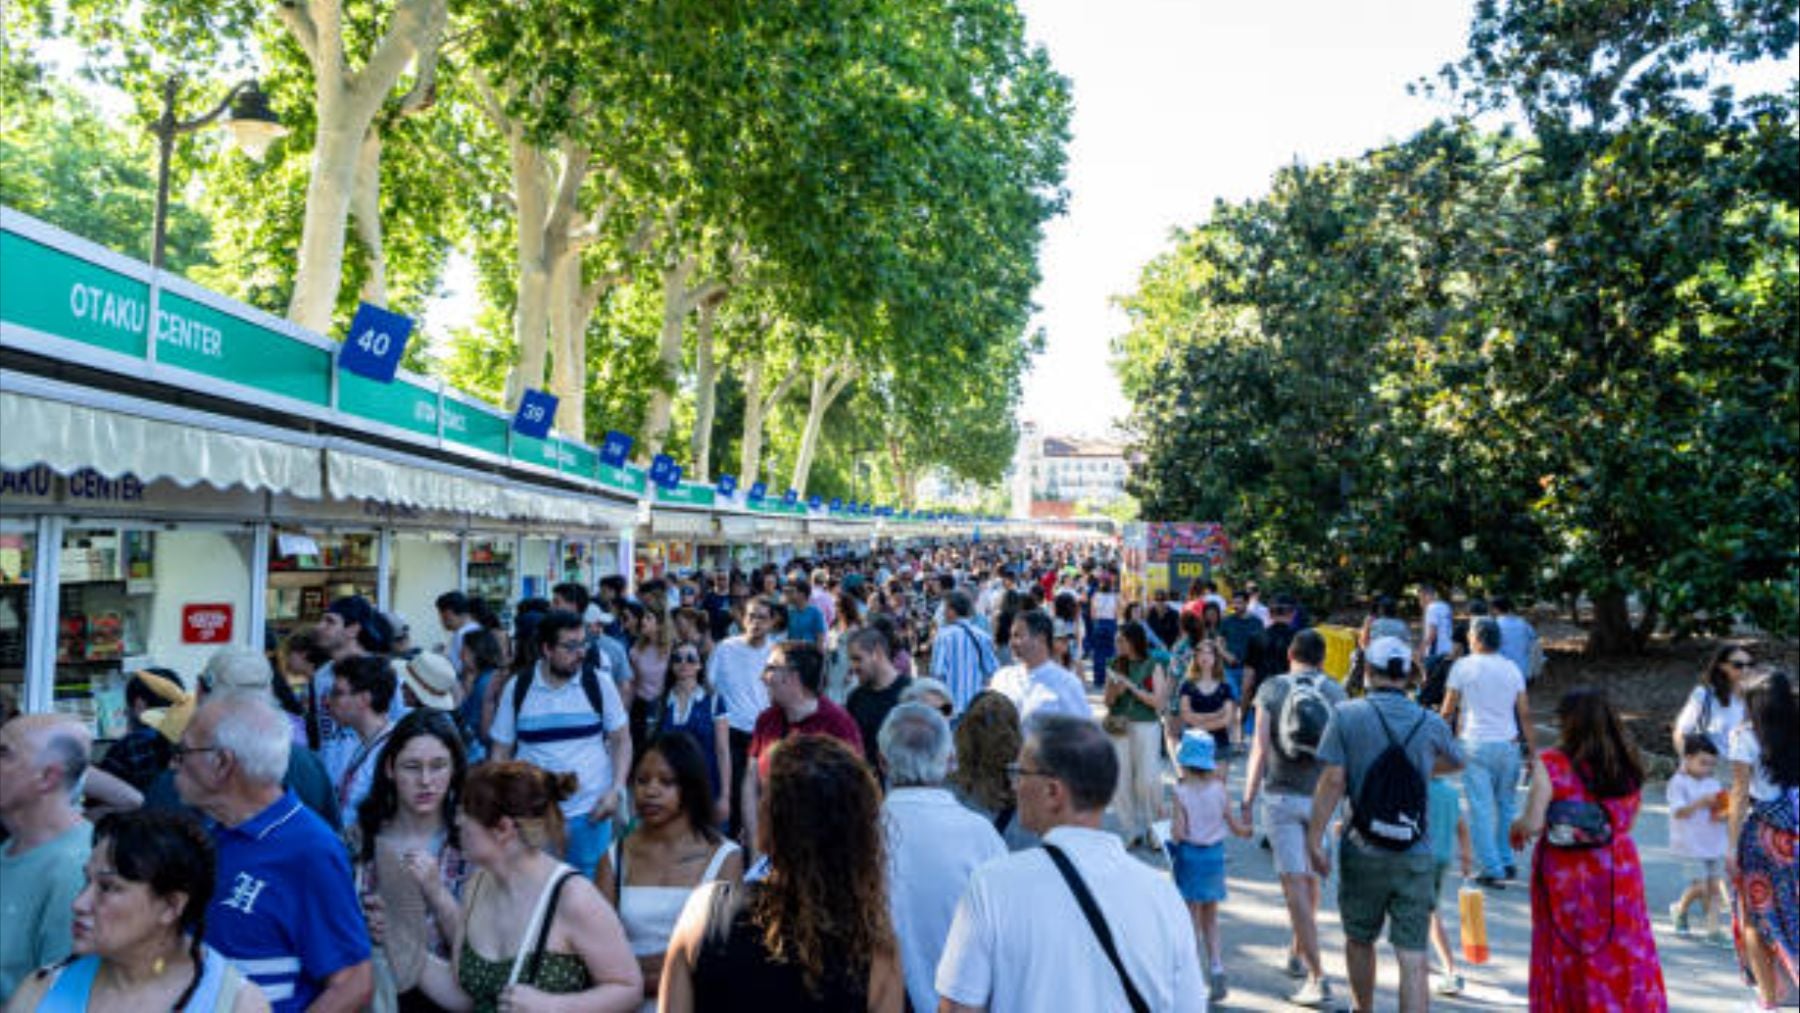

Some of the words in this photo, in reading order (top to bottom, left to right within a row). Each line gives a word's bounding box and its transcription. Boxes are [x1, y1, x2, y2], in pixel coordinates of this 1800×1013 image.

[70, 283, 144, 332] OTAKU
[156, 311, 222, 355] CENTER
[358, 329, 391, 356] 40
[523, 403, 545, 422] 39
[0, 463, 50, 496] AKU
